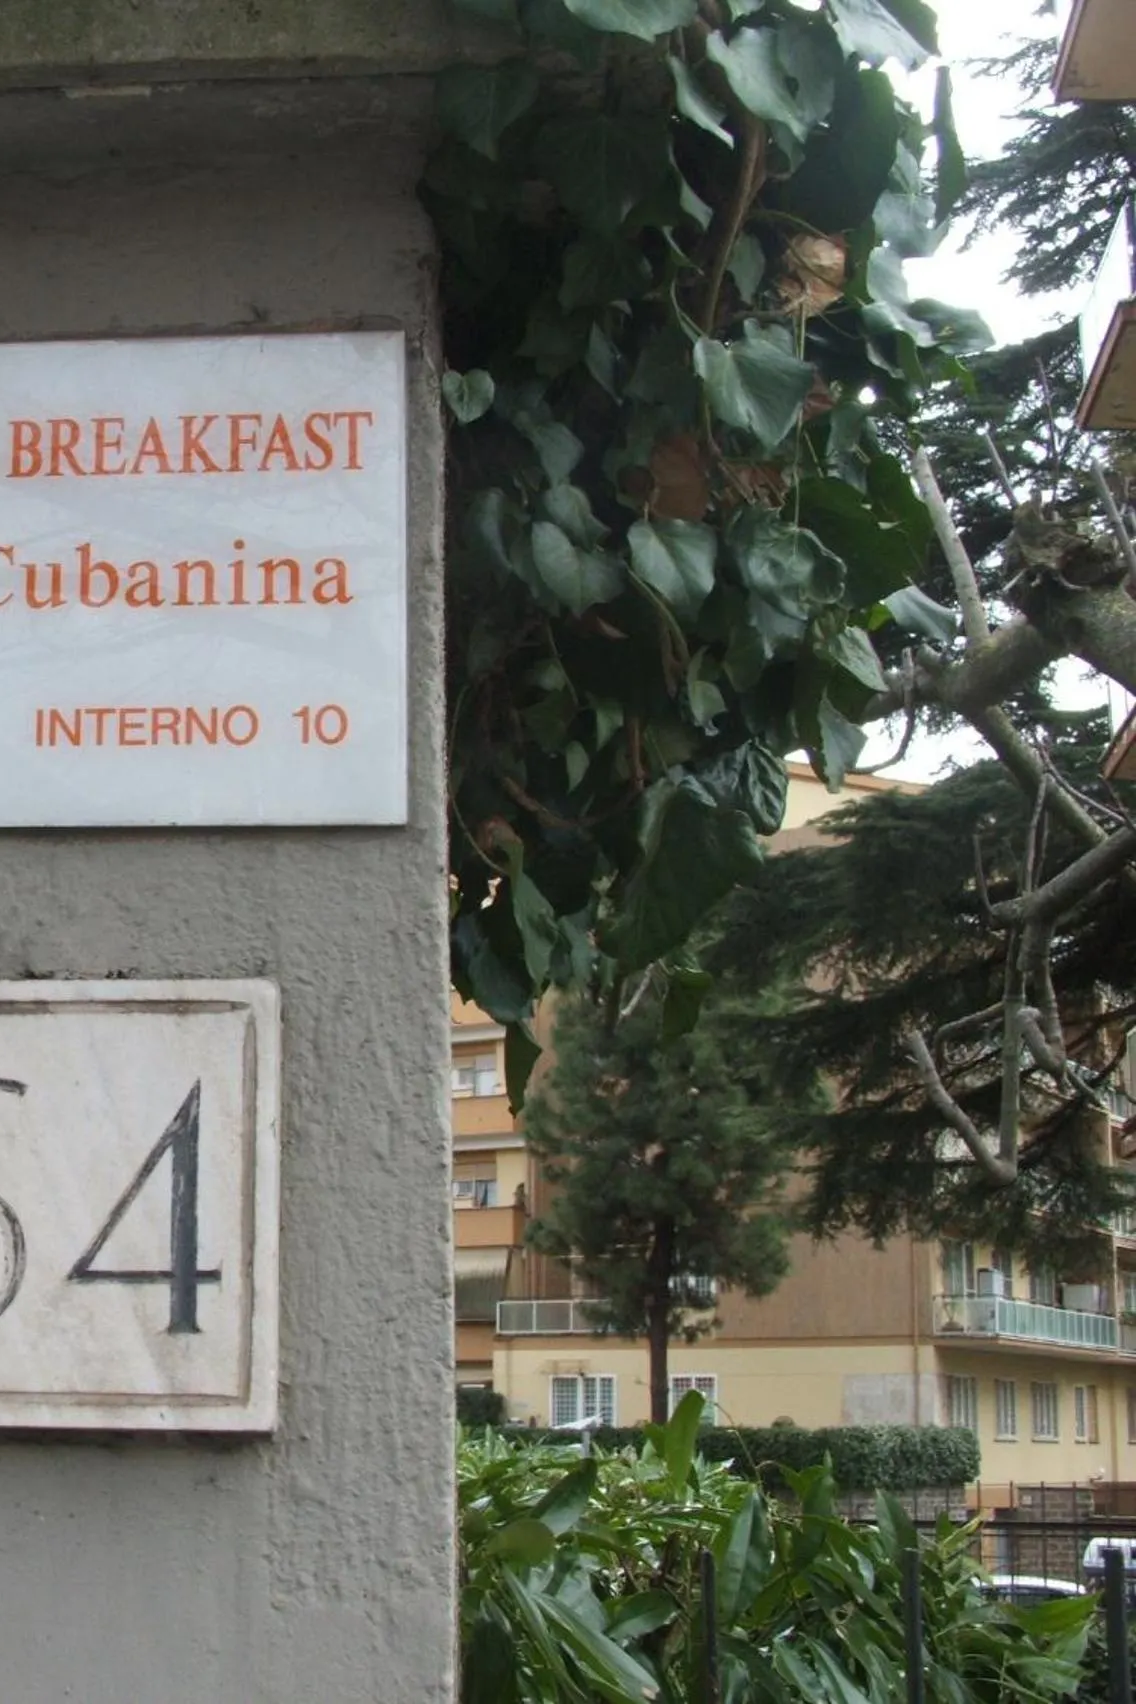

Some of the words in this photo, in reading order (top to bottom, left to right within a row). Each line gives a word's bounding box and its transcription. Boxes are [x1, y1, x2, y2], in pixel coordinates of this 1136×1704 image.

[6, 411, 374, 478] BREAKFAST
[34, 704, 260, 747] INTERNO
[291, 703, 349, 745] 10
